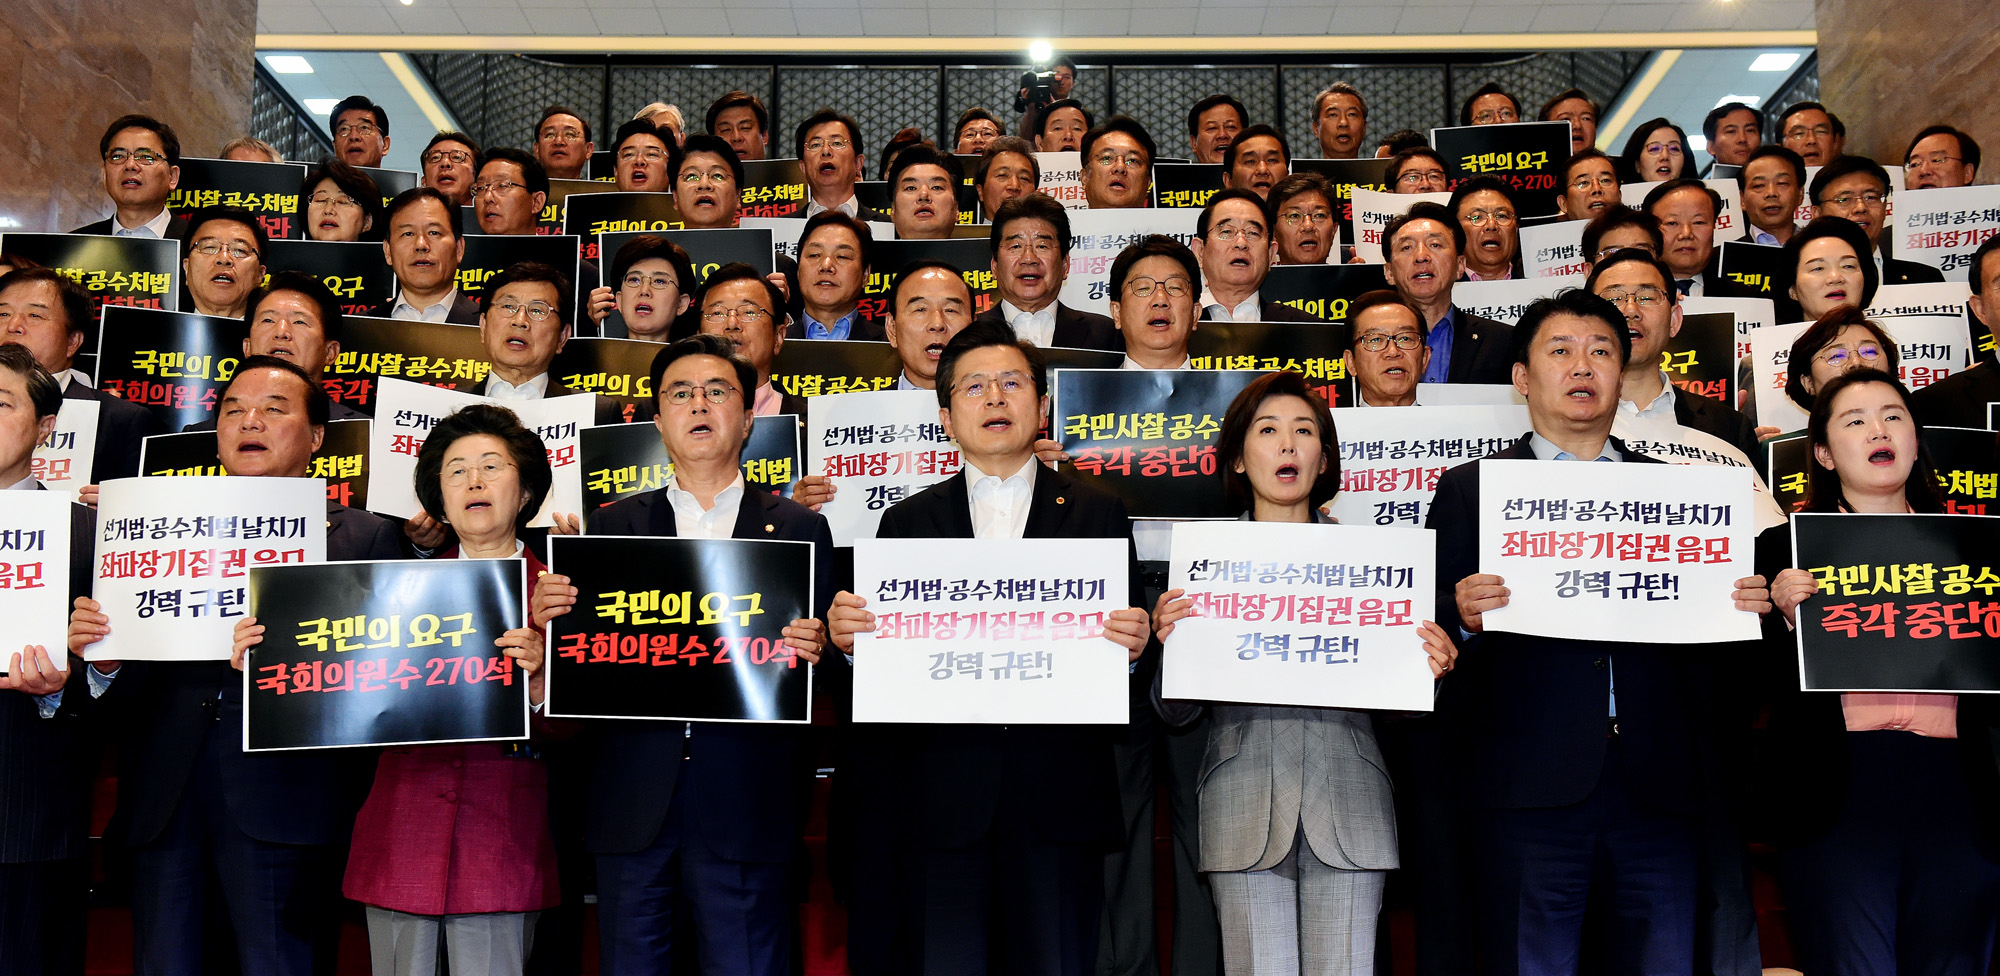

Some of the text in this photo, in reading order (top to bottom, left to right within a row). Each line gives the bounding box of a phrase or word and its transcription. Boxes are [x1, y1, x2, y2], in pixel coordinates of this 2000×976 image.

[1461, 151, 1548, 172] 국민의 요구
[166, 188, 222, 209] 민사찰
[742, 184, 803, 203] 공수처법
[84, 269, 171, 294] 공수처법
[133, 350, 242, 380] 국민의 요
[324, 352, 405, 375] 민사찰
[1901, 342, 1952, 362] 날치기
[772, 374, 825, 397] 사찰
[1670, 377, 1728, 402] 70석
[1065, 413, 1224, 440] 국민사찰 공수
[306, 454, 362, 478] 처법
[744, 458, 791, 485] 처법
[820, 450, 960, 478] 좌파장기집권
[1072, 440, 1136, 477] 즉각
[1935, 470, 1997, 498] 처법
[1372, 500, 1421, 527] 강력
[1502, 498, 1731, 526] 선거법·공수처법 날치기
[103, 516, 305, 542] 선거법·공수처법 날치기
[1502, 531, 1732, 564] 좌파장기집권 음모
[100, 548, 246, 579] 좌파장기집권
[1188, 559, 1413, 588] 선거법·공수처법 날치기
[877, 579, 1105, 602] 선거법·공수처법 날치기
[1555, 570, 1679, 601] 강력 규탄!
[1810, 563, 1938, 596] 국민사찰
[136, 588, 246, 620] 강력 규탄
[596, 590, 764, 626] 국민의 요구
[1186, 590, 1413, 627] 좌파장기집권 음모
[295, 614, 475, 653] 국민의 요구
[876, 609, 1108, 643] 좌파장기집권 음모
[1822, 602, 1900, 638] 즉각
[558, 631, 798, 670] 국회의원수 270석
[1237, 633, 1358, 664] 강력 규탄!
[256, 652, 514, 695] 국회의원수 270석
[930, 652, 1052, 680] 강력 규탄!
